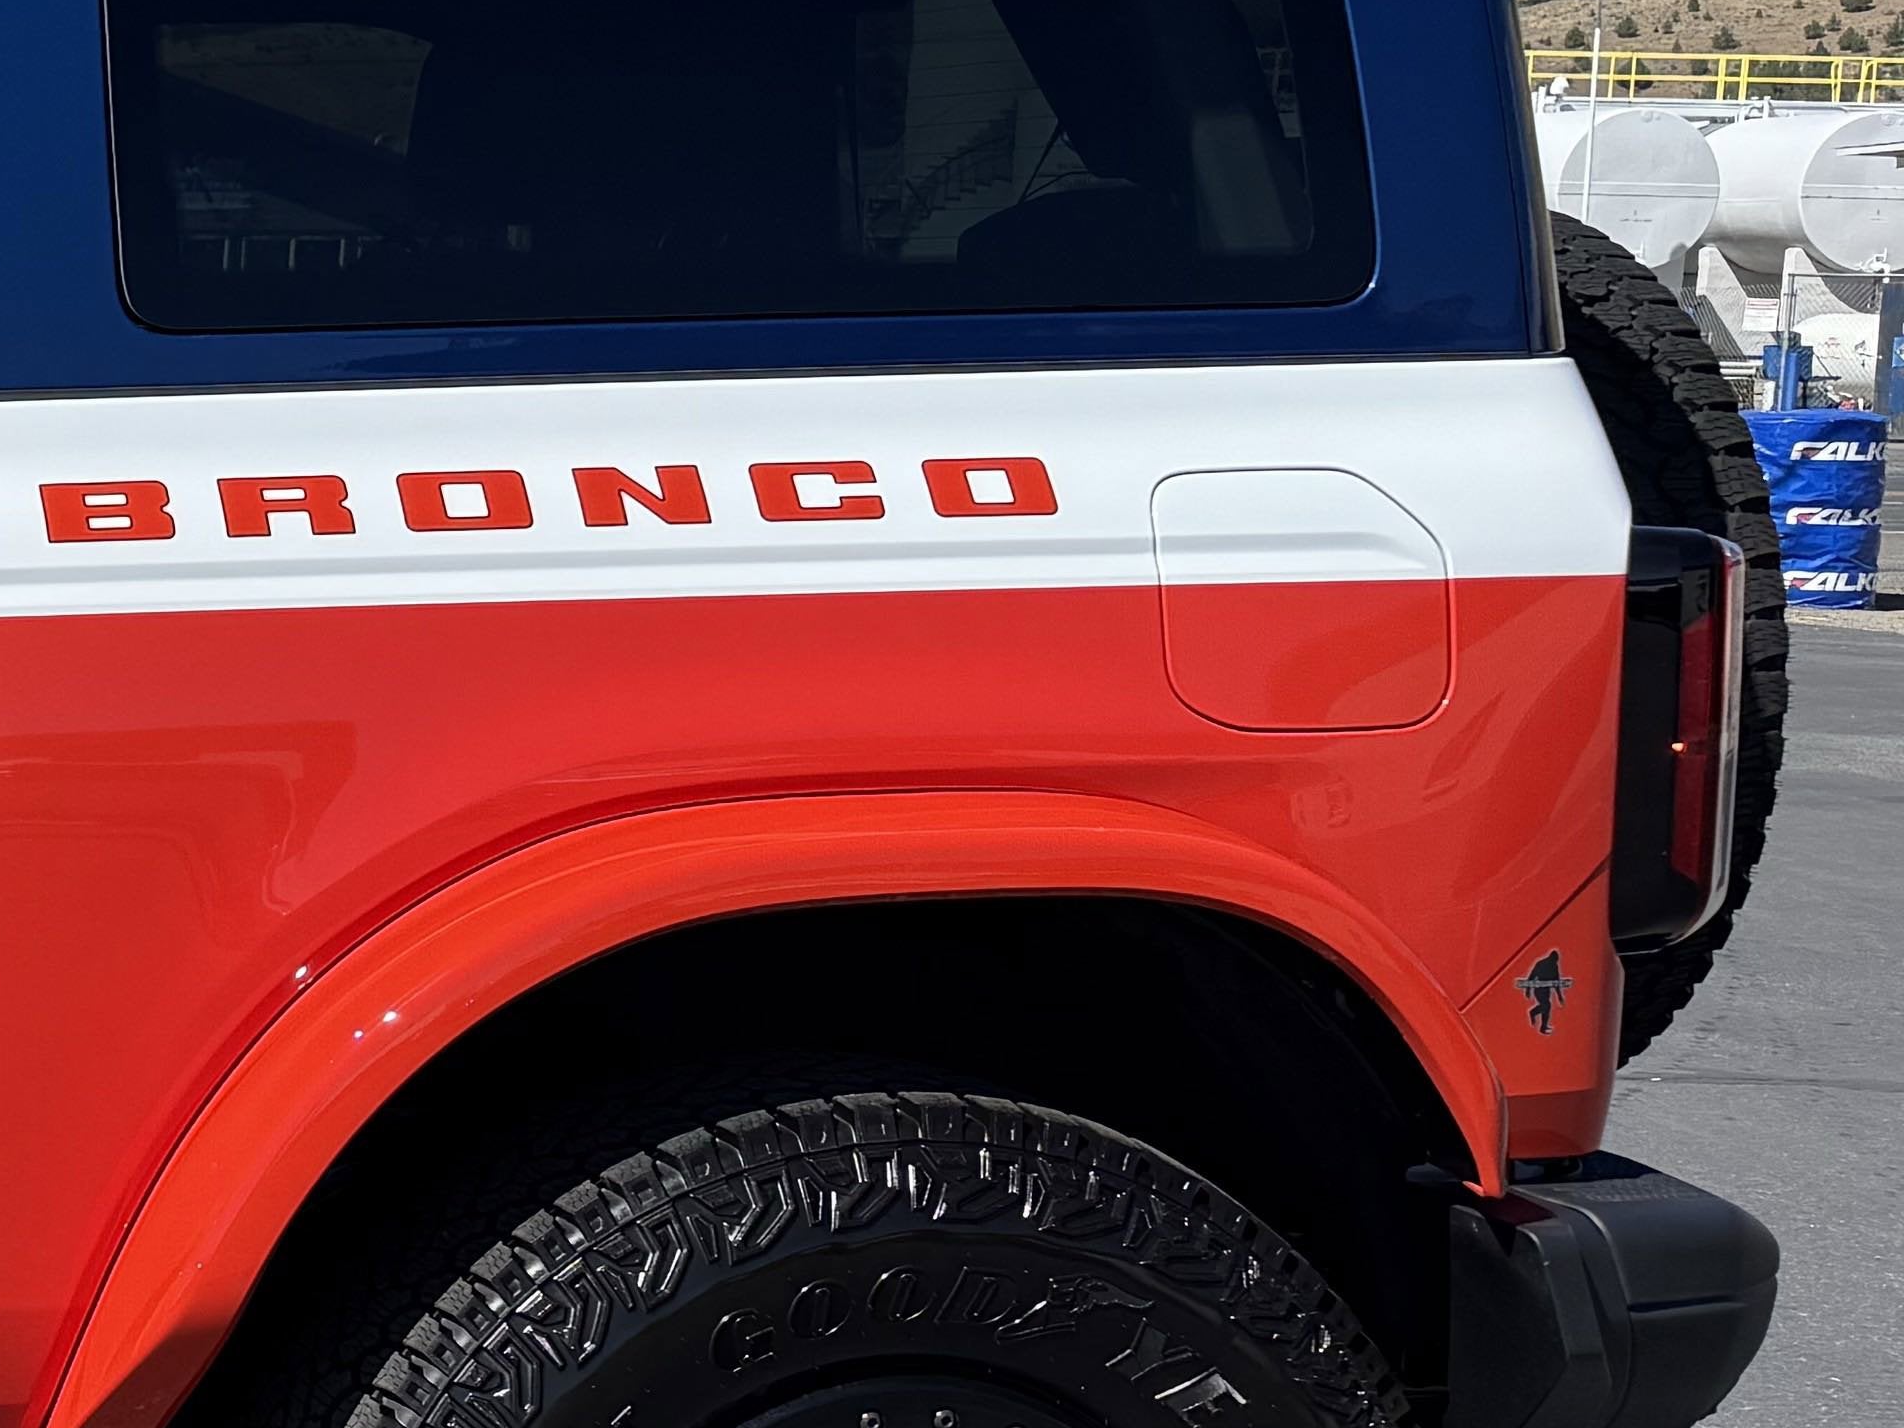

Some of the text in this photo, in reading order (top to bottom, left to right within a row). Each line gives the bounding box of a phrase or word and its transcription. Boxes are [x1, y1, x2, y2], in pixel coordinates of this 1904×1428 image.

[1790, 441, 1888, 461] FALK
[38, 456, 1059, 543] BRONCO
[1786, 507, 1882, 526] FALK
[1783, 570, 1879, 592] FALK
